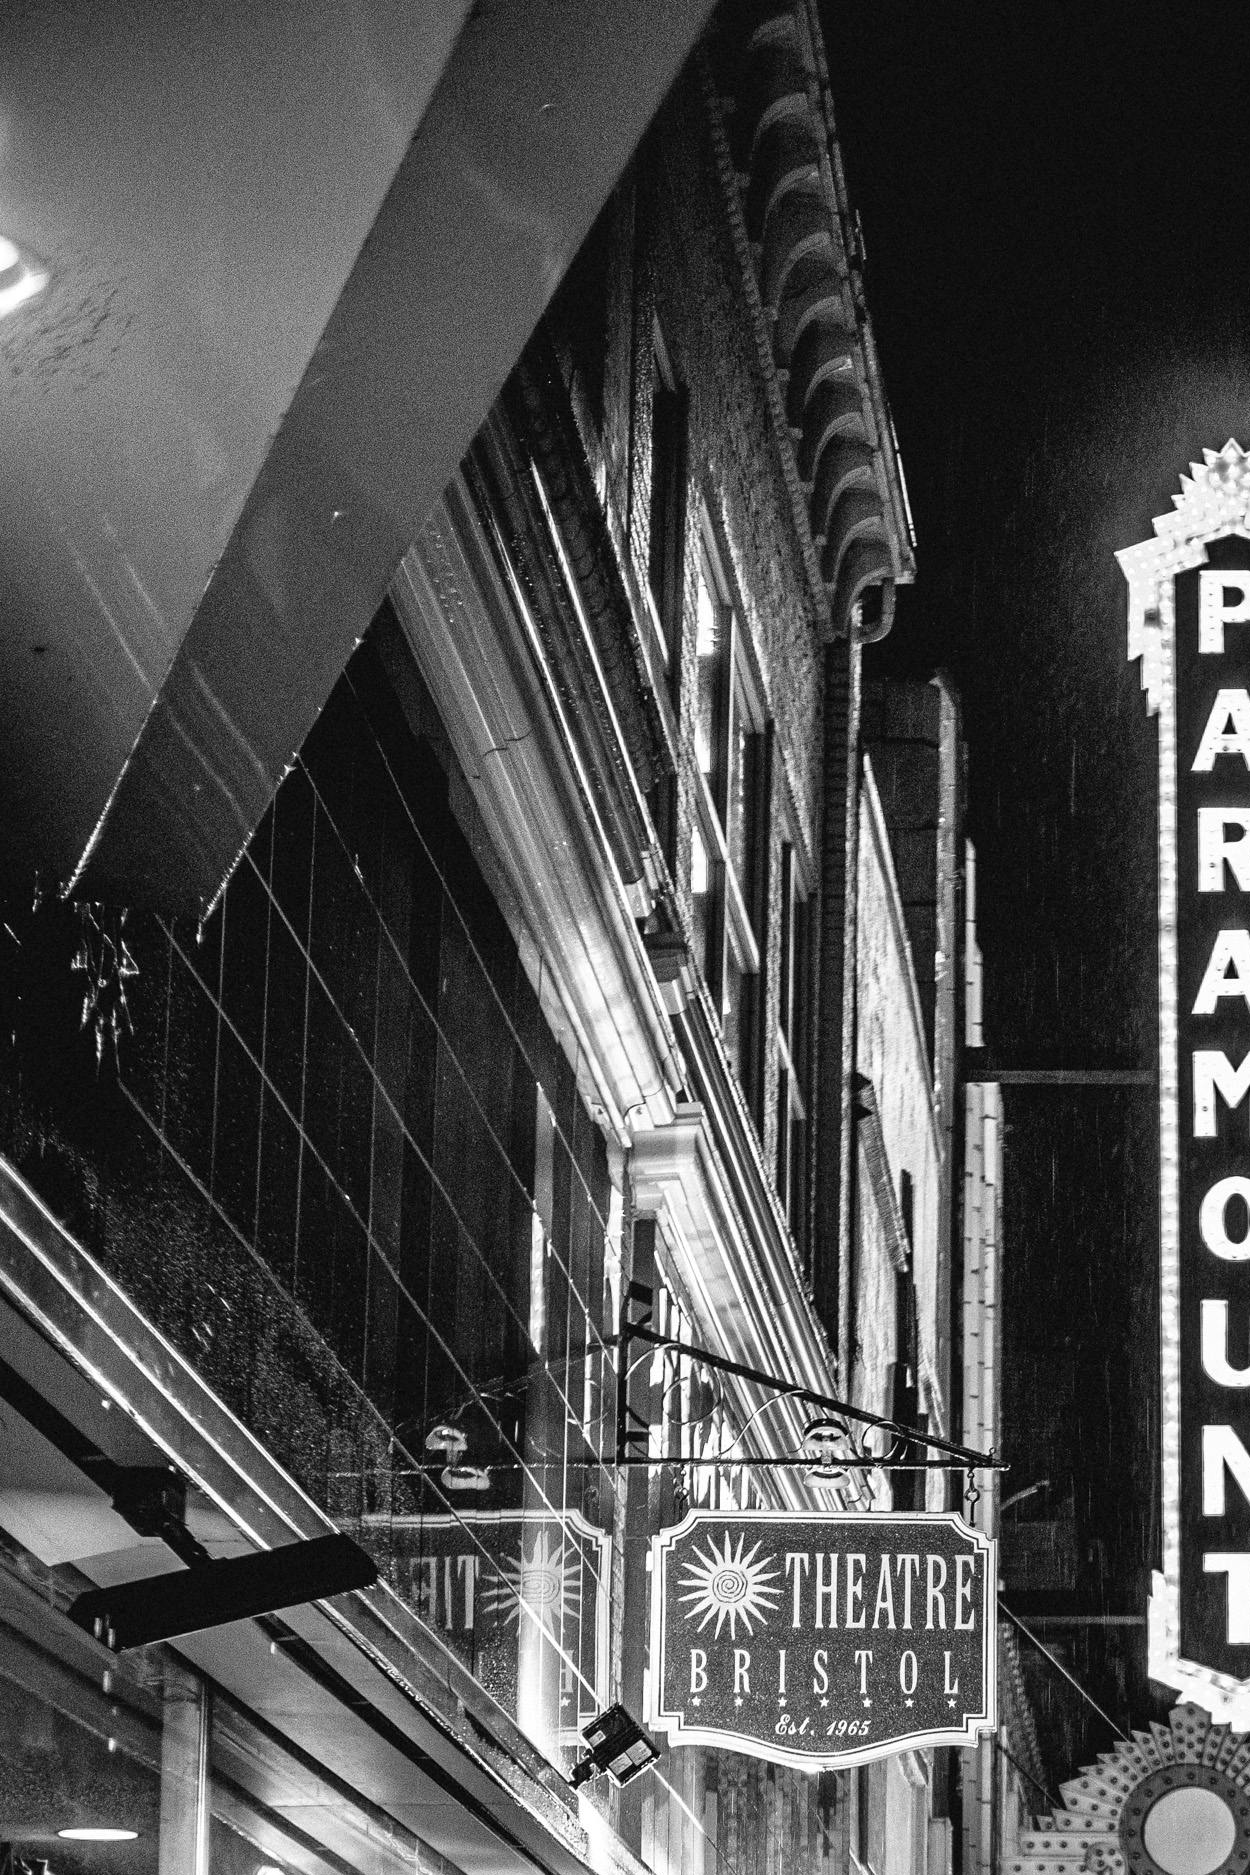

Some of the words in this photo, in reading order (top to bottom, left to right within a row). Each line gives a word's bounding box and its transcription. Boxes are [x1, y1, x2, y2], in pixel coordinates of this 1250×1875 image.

[785, 1552, 976, 1631] THEATRE
[689, 1649, 959, 1695] BRISTOL
[774, 1714, 815, 1736] Est.
[826, 1719, 872, 1736] 1965
